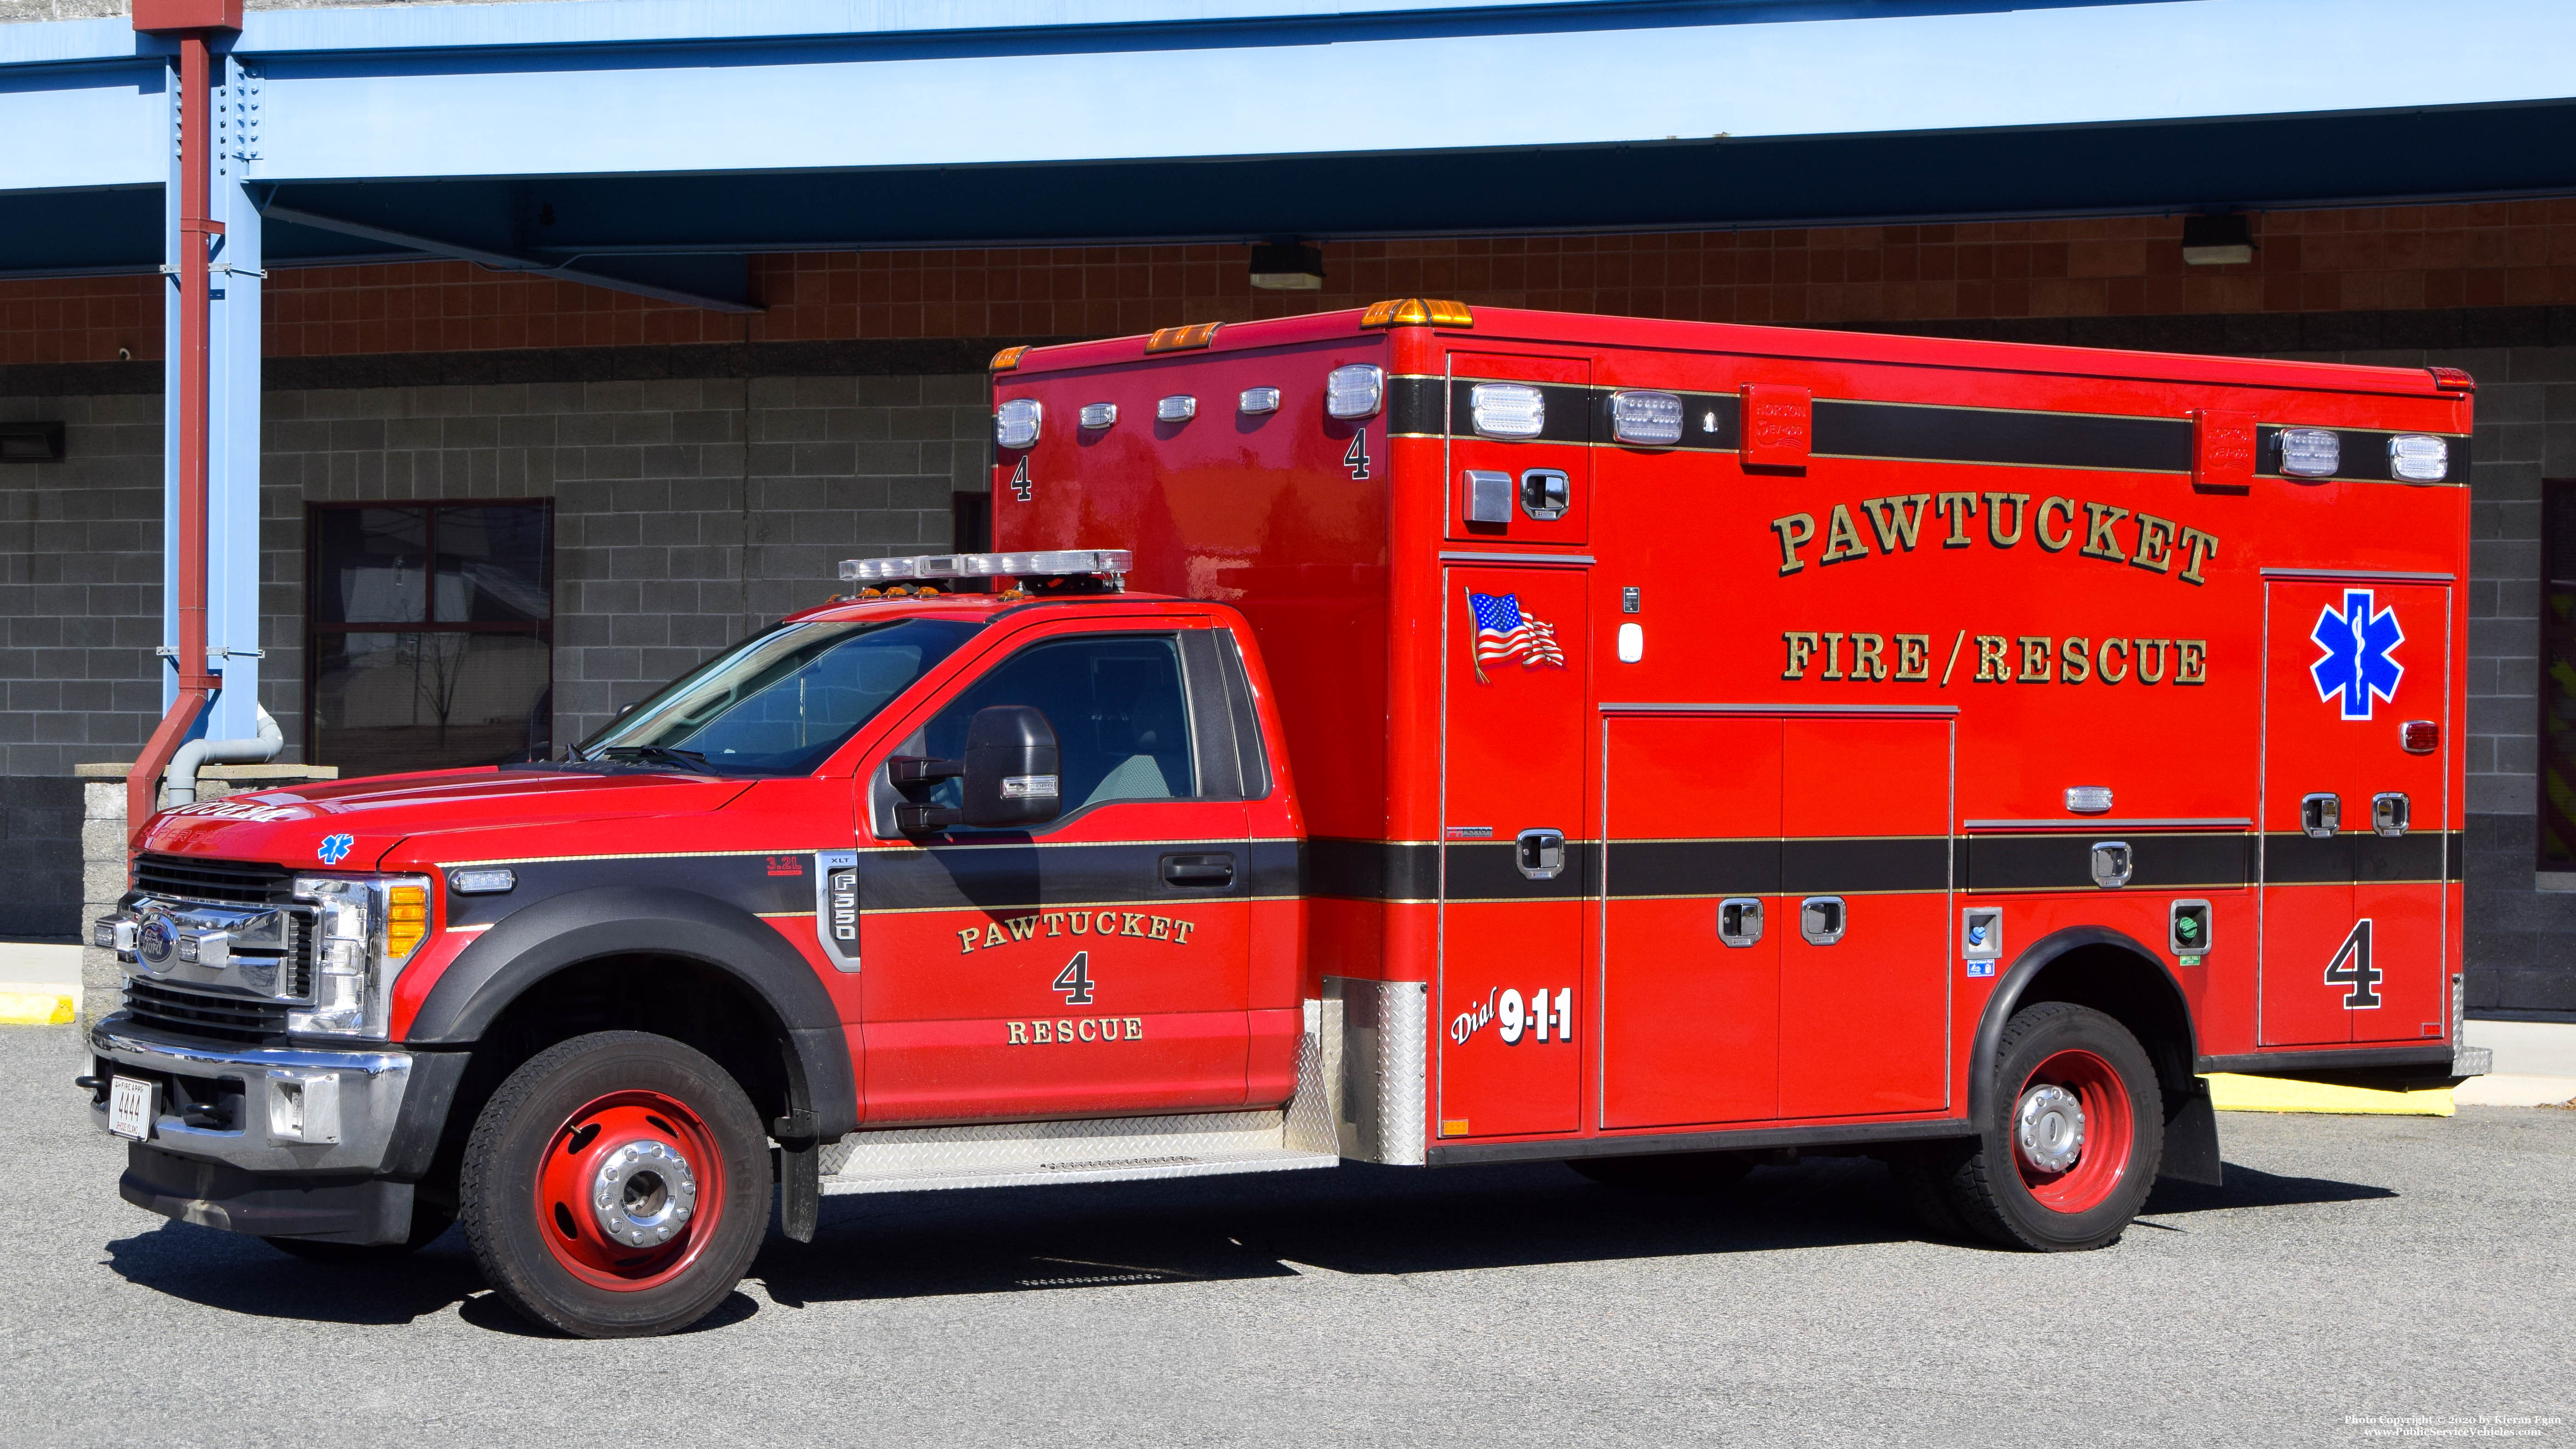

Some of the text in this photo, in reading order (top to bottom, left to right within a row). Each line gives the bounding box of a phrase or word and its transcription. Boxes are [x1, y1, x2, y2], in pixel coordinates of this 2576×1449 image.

[1756, 403, 1806, 417] HORTON
[1344, 428, 1370, 480] 4
[1011, 455, 1032, 502] 4
[1771, 491, 2220, 586] PAWTUCKET
[140, 825, 192, 842] SUPER
[766, 857, 802, 870] 3.2L
[834, 874, 856, 941] F550
[143, 930, 164, 955] Ford
[957, 911, 1195, 954] PAWTUCKET
[1052, 951, 1094, 1005] 4
[2324, 918, 2383, 1010] 4
[1007, 1017, 1143, 1046] RESCUE
[1451, 986, 1573, 1046] Dial 9-1-1
[121, 1081, 131, 1091] FIRE
[119, 1091, 140, 1122] 4444
[127, 1124, 138, 1134] ISLAND
